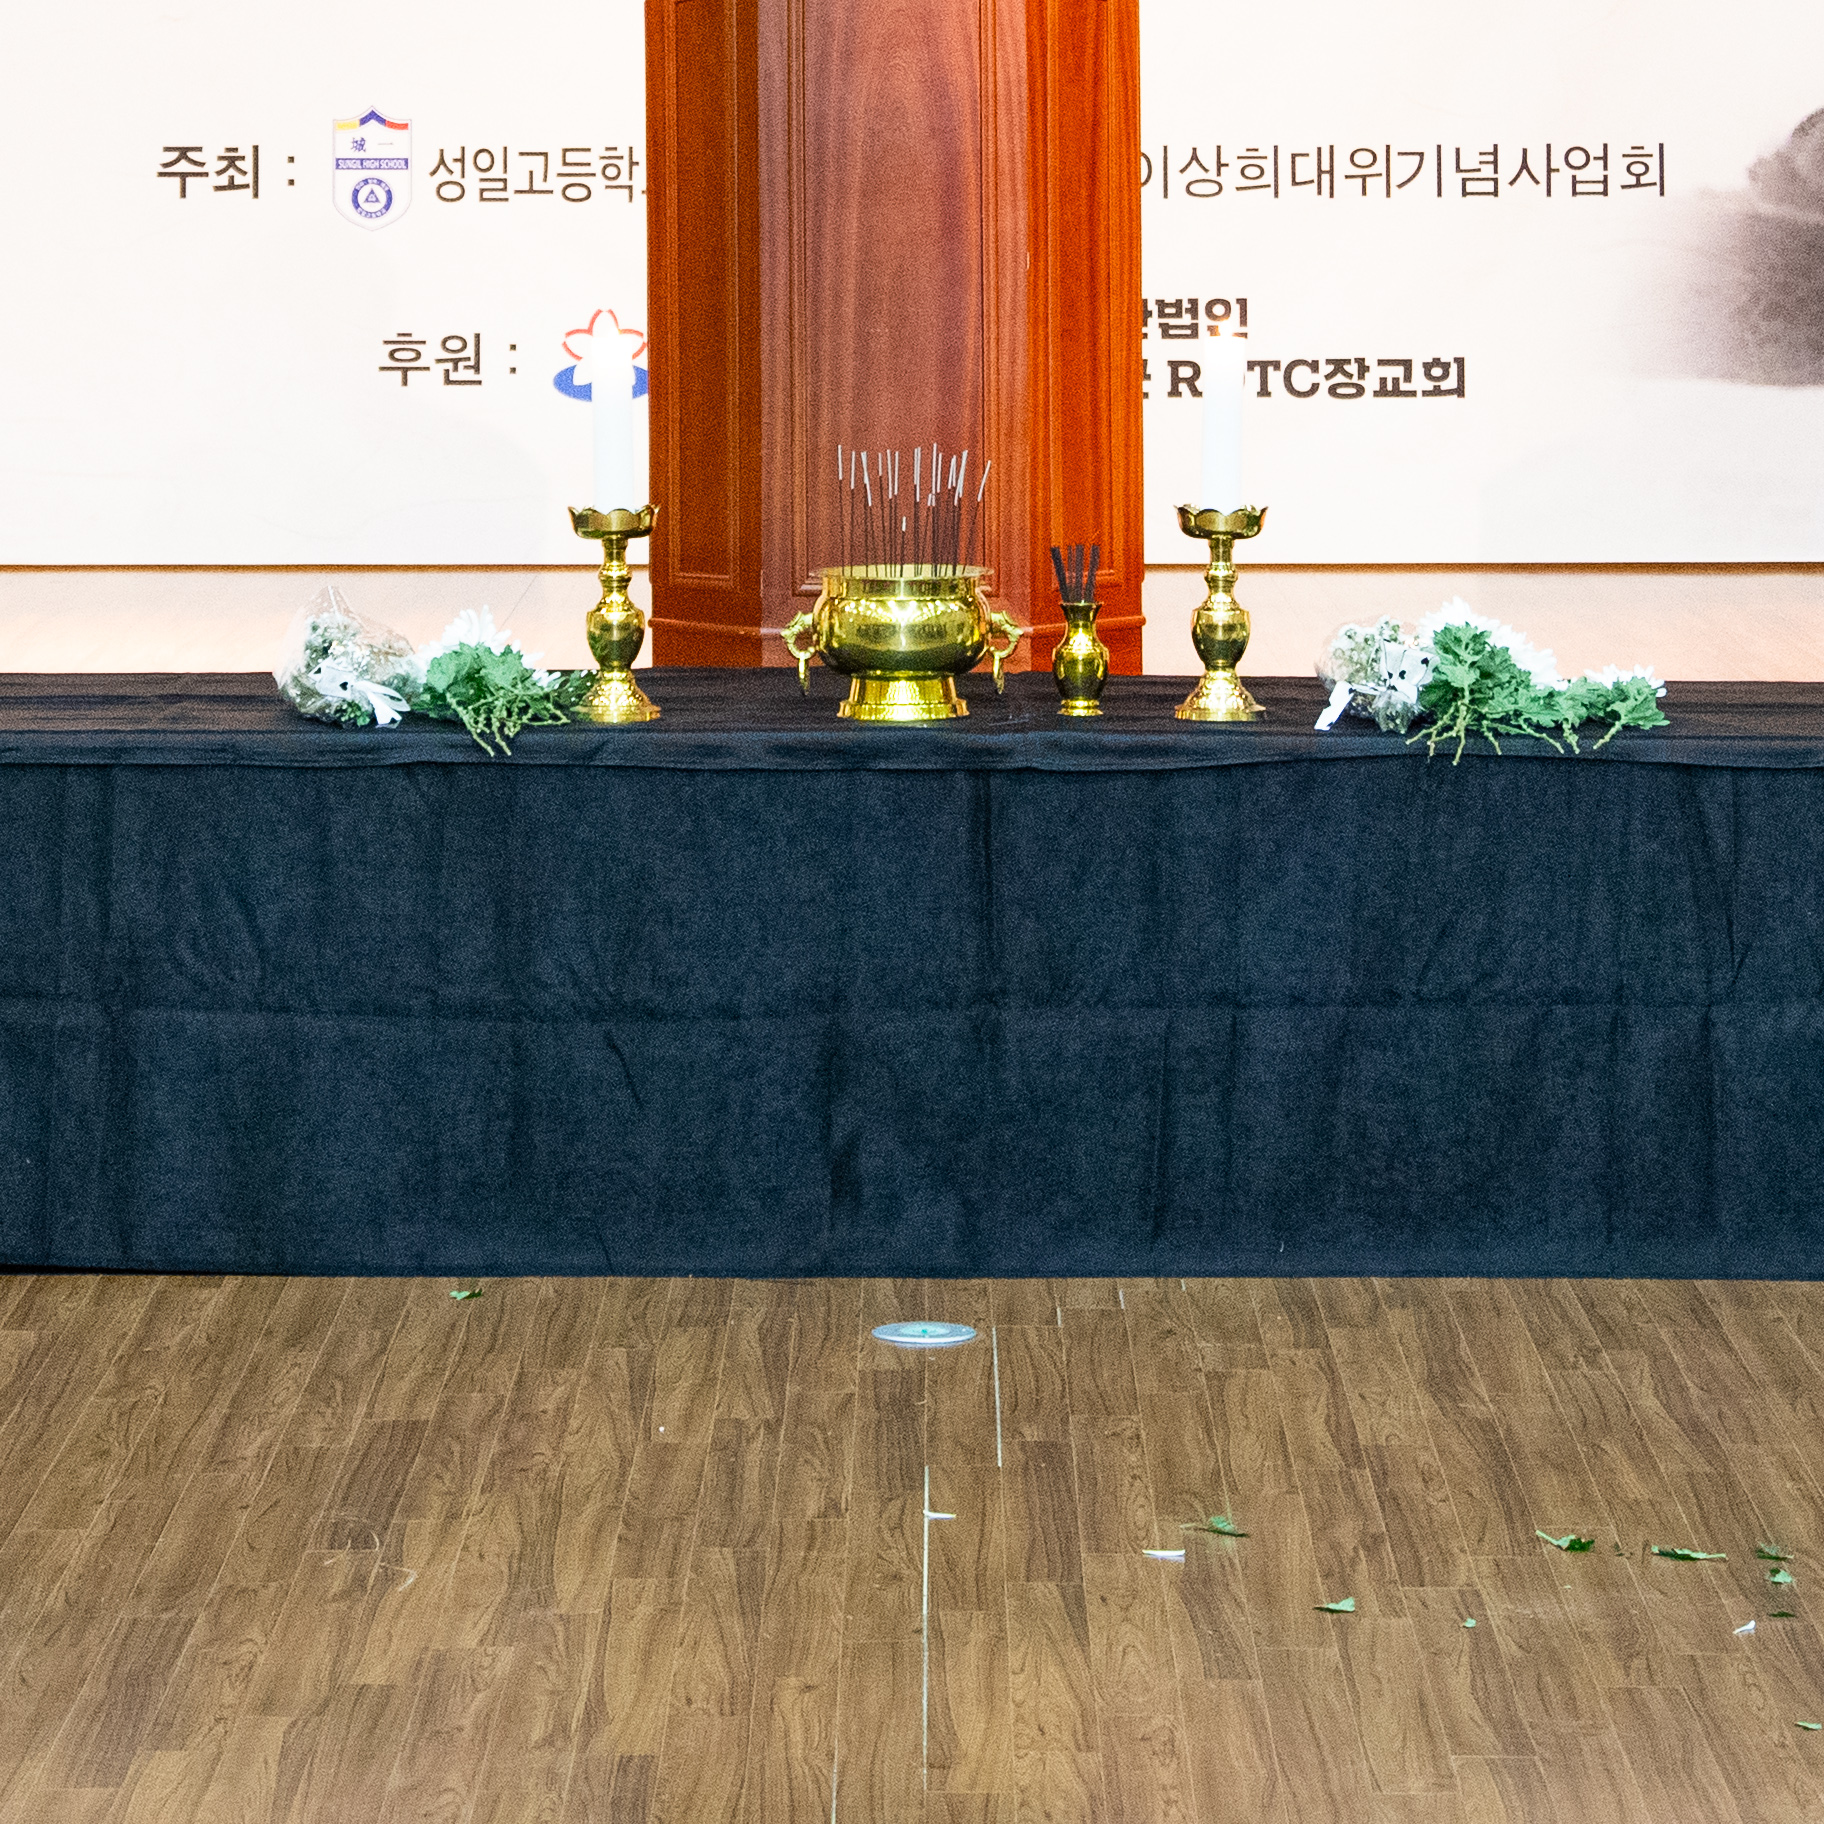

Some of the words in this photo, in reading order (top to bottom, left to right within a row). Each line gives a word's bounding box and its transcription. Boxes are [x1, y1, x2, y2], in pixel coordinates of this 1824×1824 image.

[158, 145, 259, 198] 주최
[430, 146, 647, 203] 성일고등학
[338, 159, 362, 170] SUNGIL
[363, 159, 380, 170] HIGH
[380, 159, 407, 170] SCHOOL
[1142, 143, 1665, 199] 이상희대위기념사업회
[379, 333, 482, 387] 후원
[1167, 357, 1466, 400] RTC장교회
